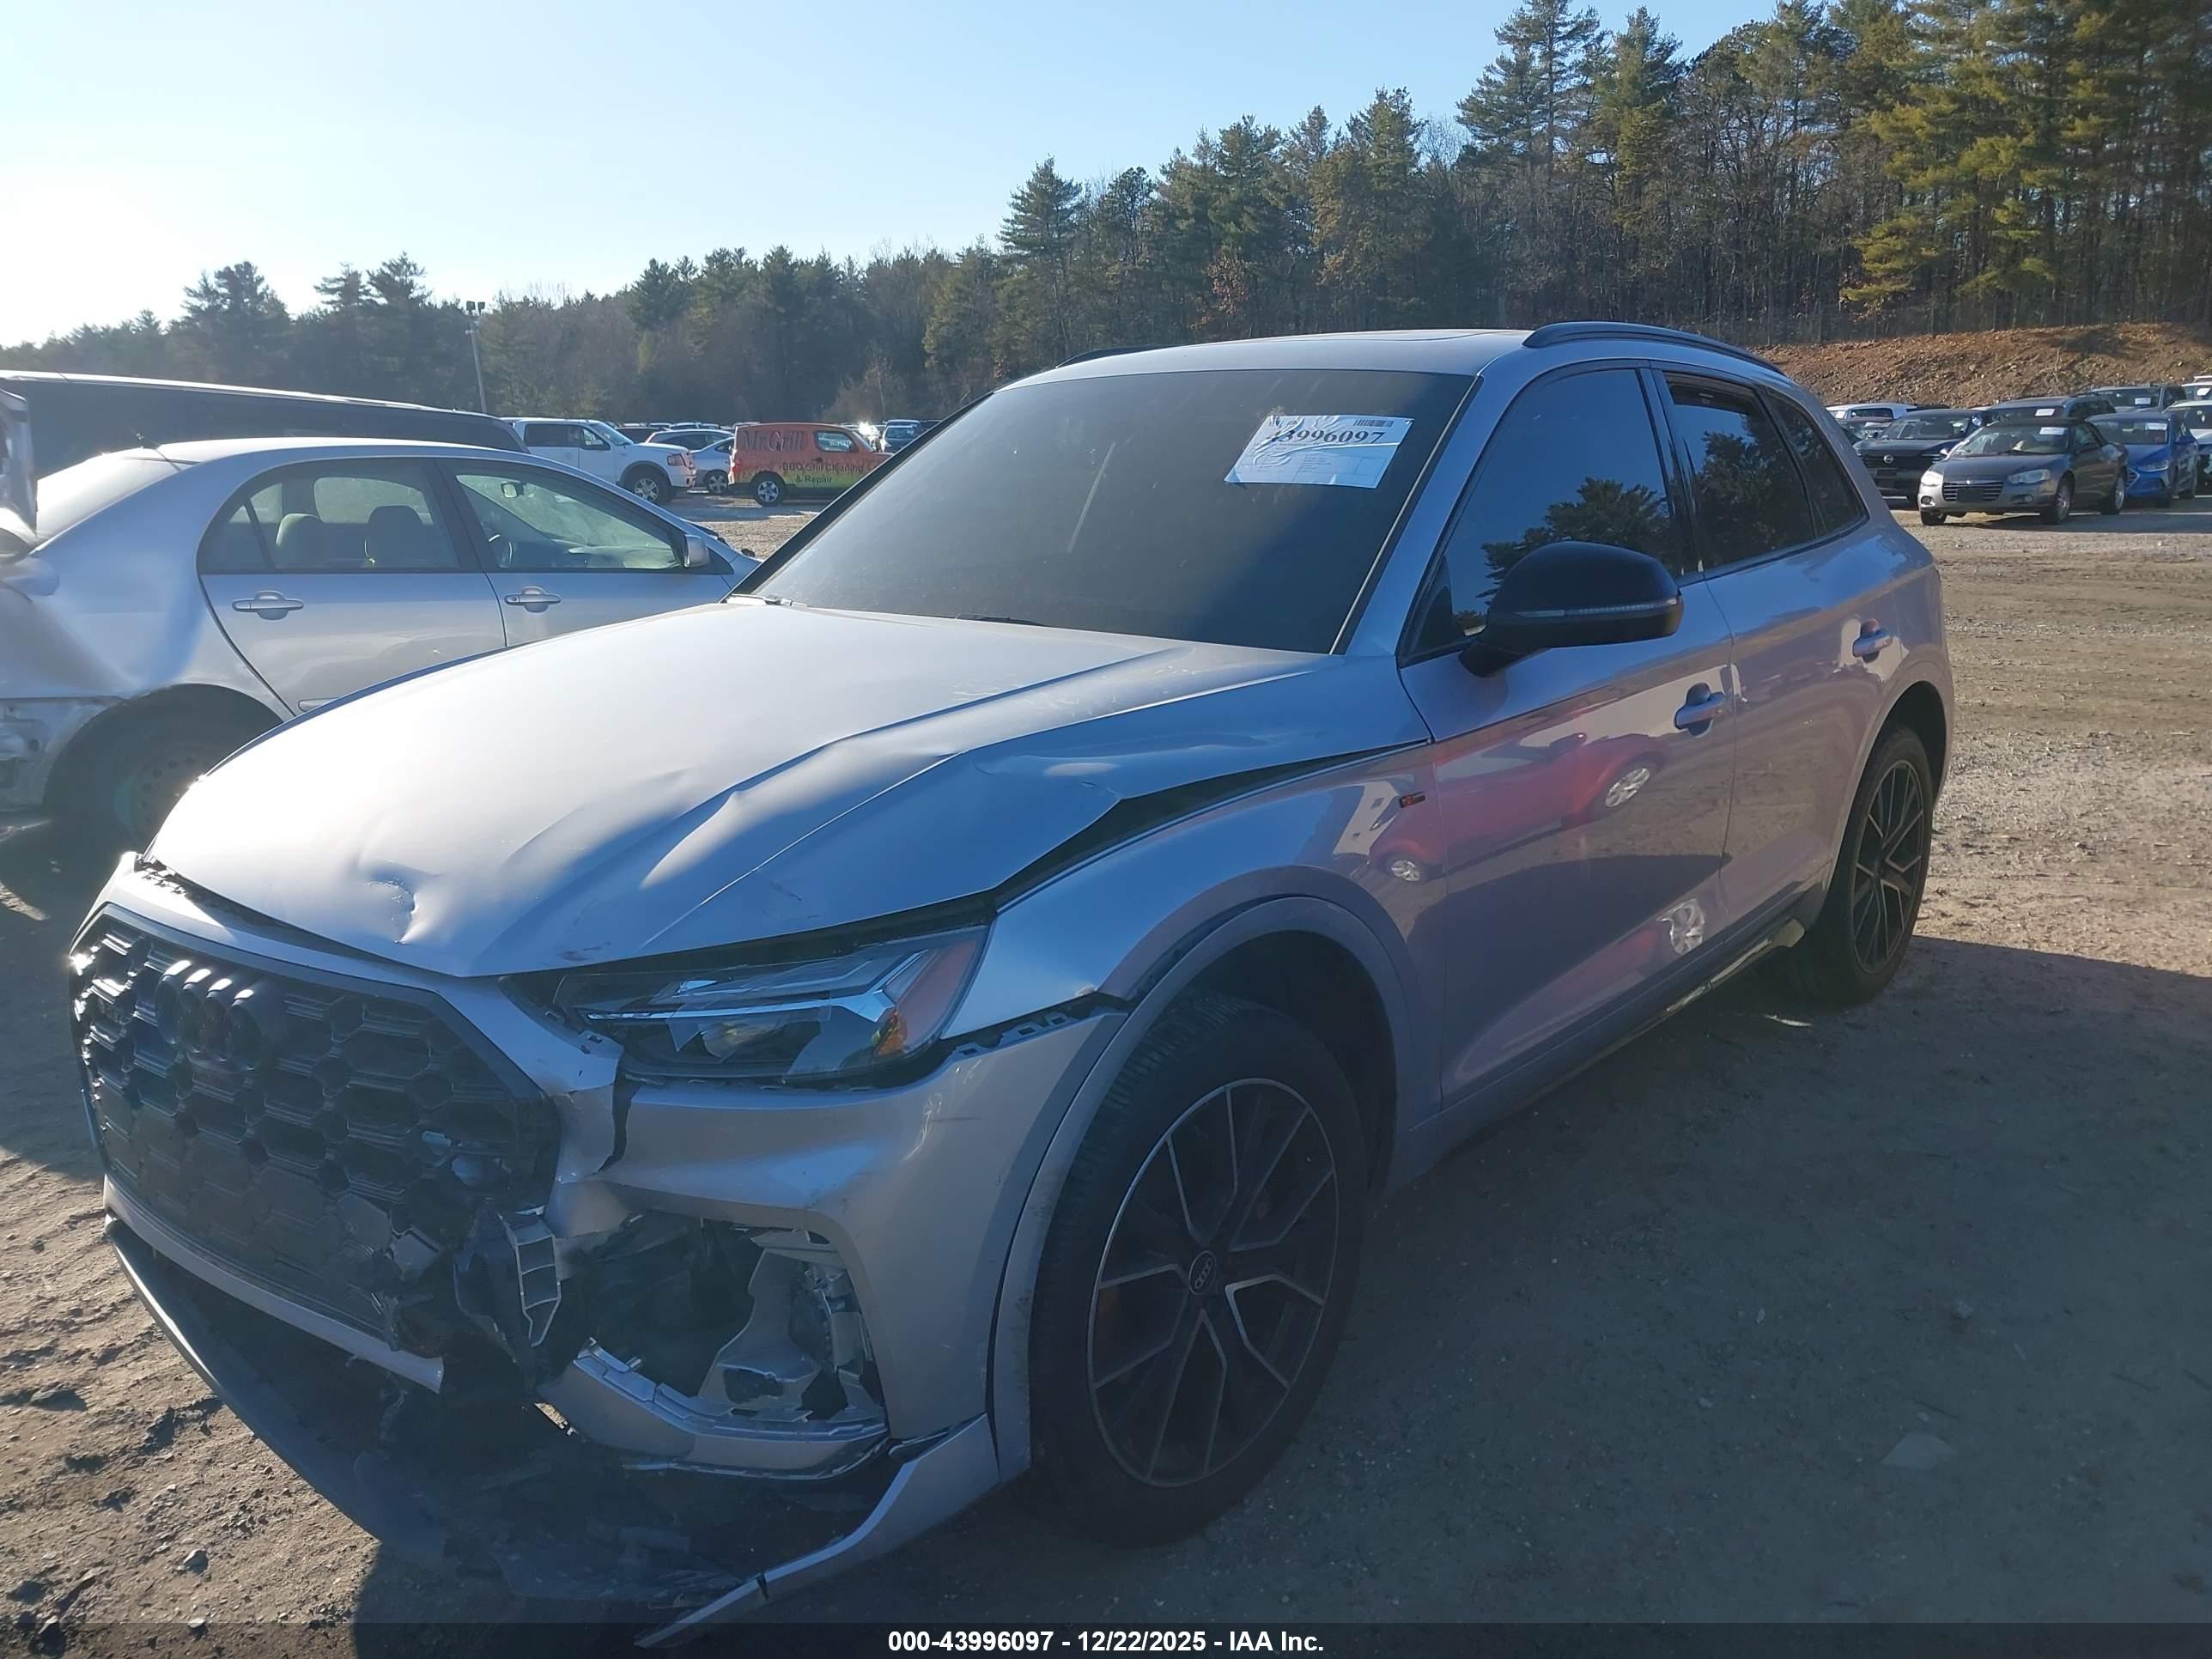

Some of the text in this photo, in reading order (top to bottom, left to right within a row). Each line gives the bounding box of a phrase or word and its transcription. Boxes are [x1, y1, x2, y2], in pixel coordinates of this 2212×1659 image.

[782, 462, 865, 474] BBQ Grill Cleaning
[796, 475, 833, 485] & Repair
